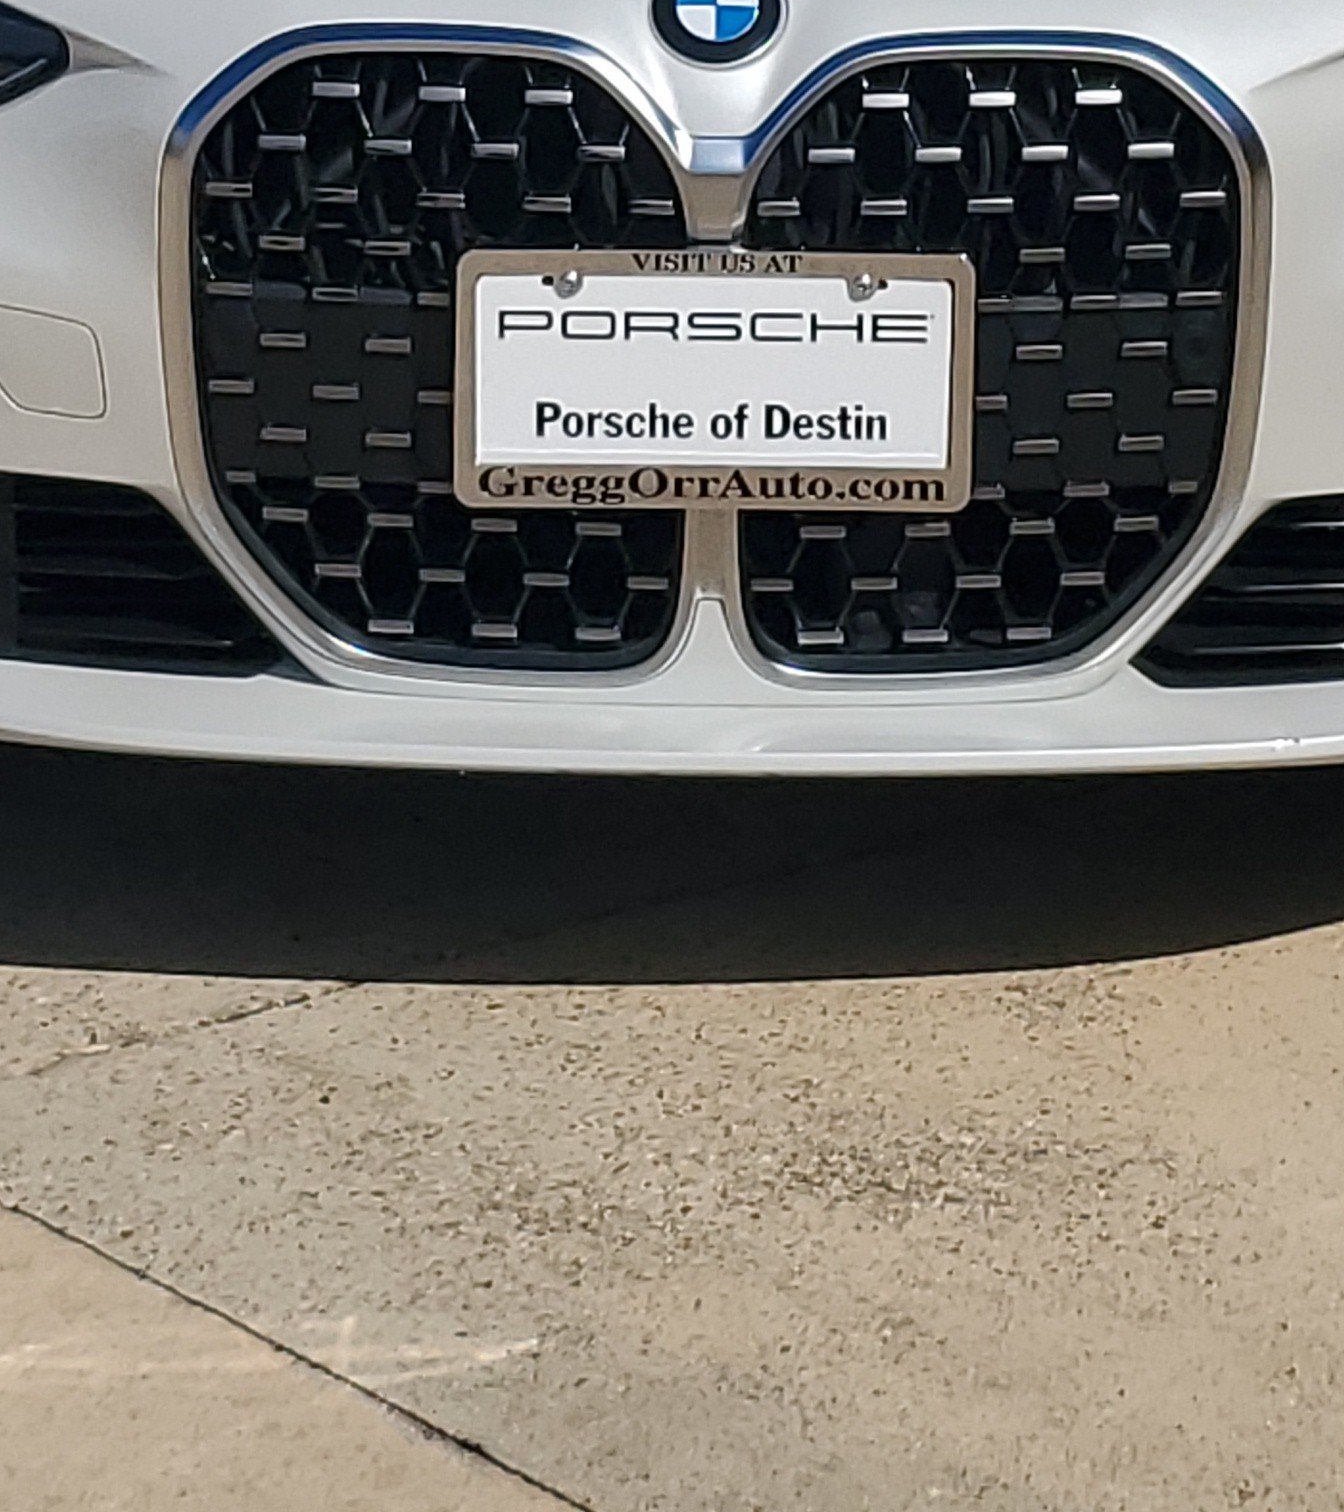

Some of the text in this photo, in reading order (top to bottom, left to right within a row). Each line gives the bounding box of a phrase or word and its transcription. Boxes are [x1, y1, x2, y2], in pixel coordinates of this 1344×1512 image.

[632, 253, 803, 273] VISIT US AT
[498, 310, 928, 343] PORSCHE
[535, 401, 887, 441] Porsche of Destin
[478, 465, 944, 505] GreggOrrAuto.com
